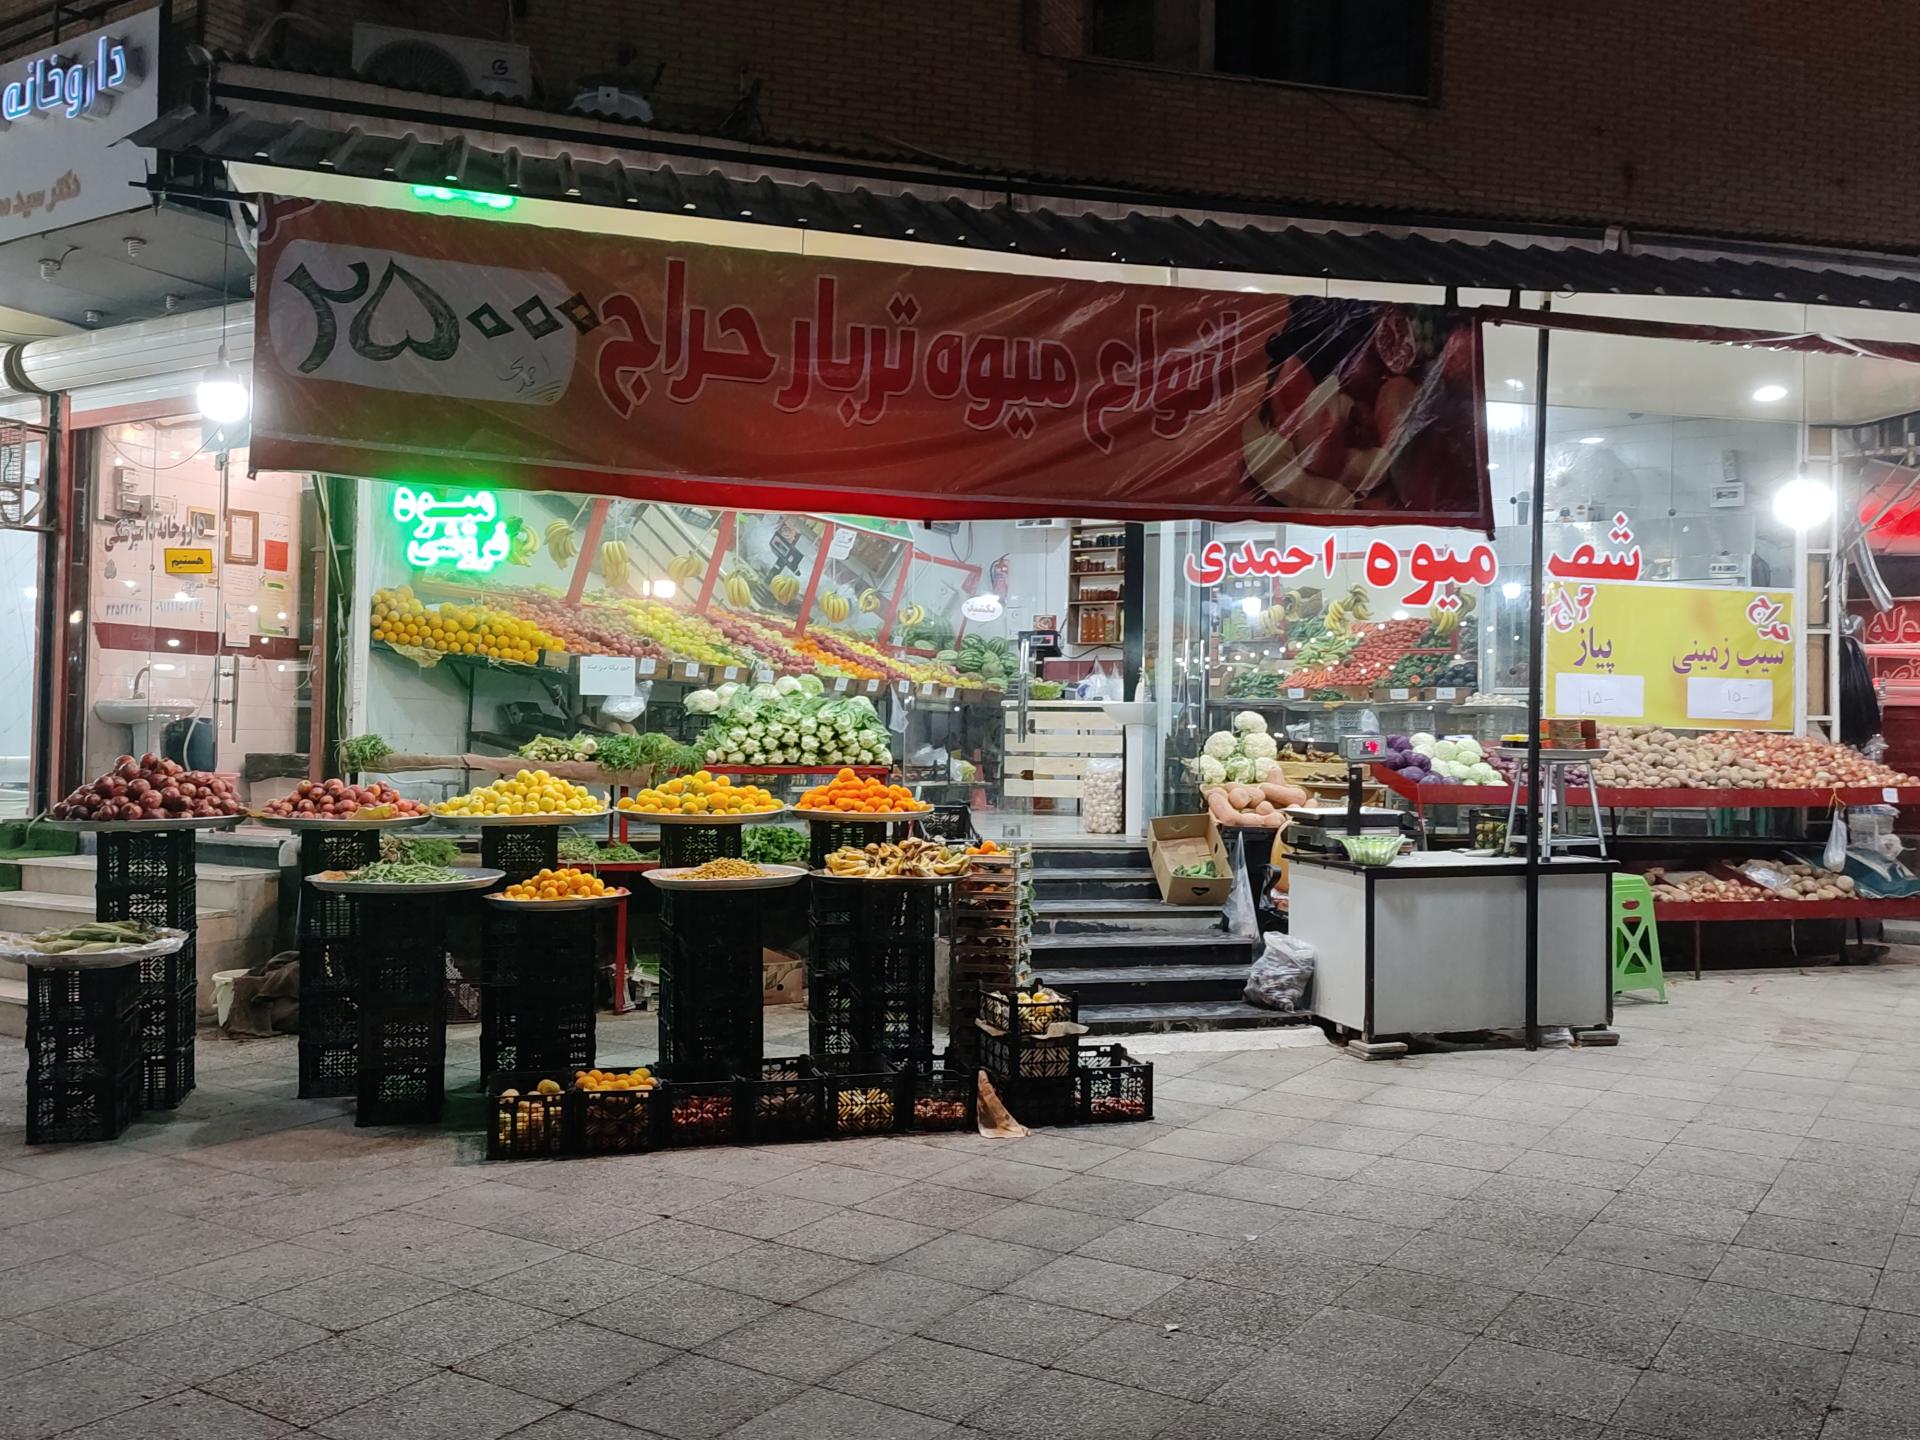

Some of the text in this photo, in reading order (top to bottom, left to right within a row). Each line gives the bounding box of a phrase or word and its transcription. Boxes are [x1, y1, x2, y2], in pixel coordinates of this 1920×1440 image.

[2, 35, 127, 121] داروخانه
[283, 256, 1243, 455] انواع میوه تربار حراج ۲۵۰۰۰
[393, 486, 497, 539] میوه
[406, 520, 511, 571] فروشی
[1183, 533, 1338, 588] احمدی
[1363, 538, 1499, 613] میوه
[1548, 584, 1597, 633] حراج
[1746, 595, 1793, 644] حراج
[1573, 626, 1616, 675] پیاز
[1672, 636, 1785, 675] سیب زمینی
